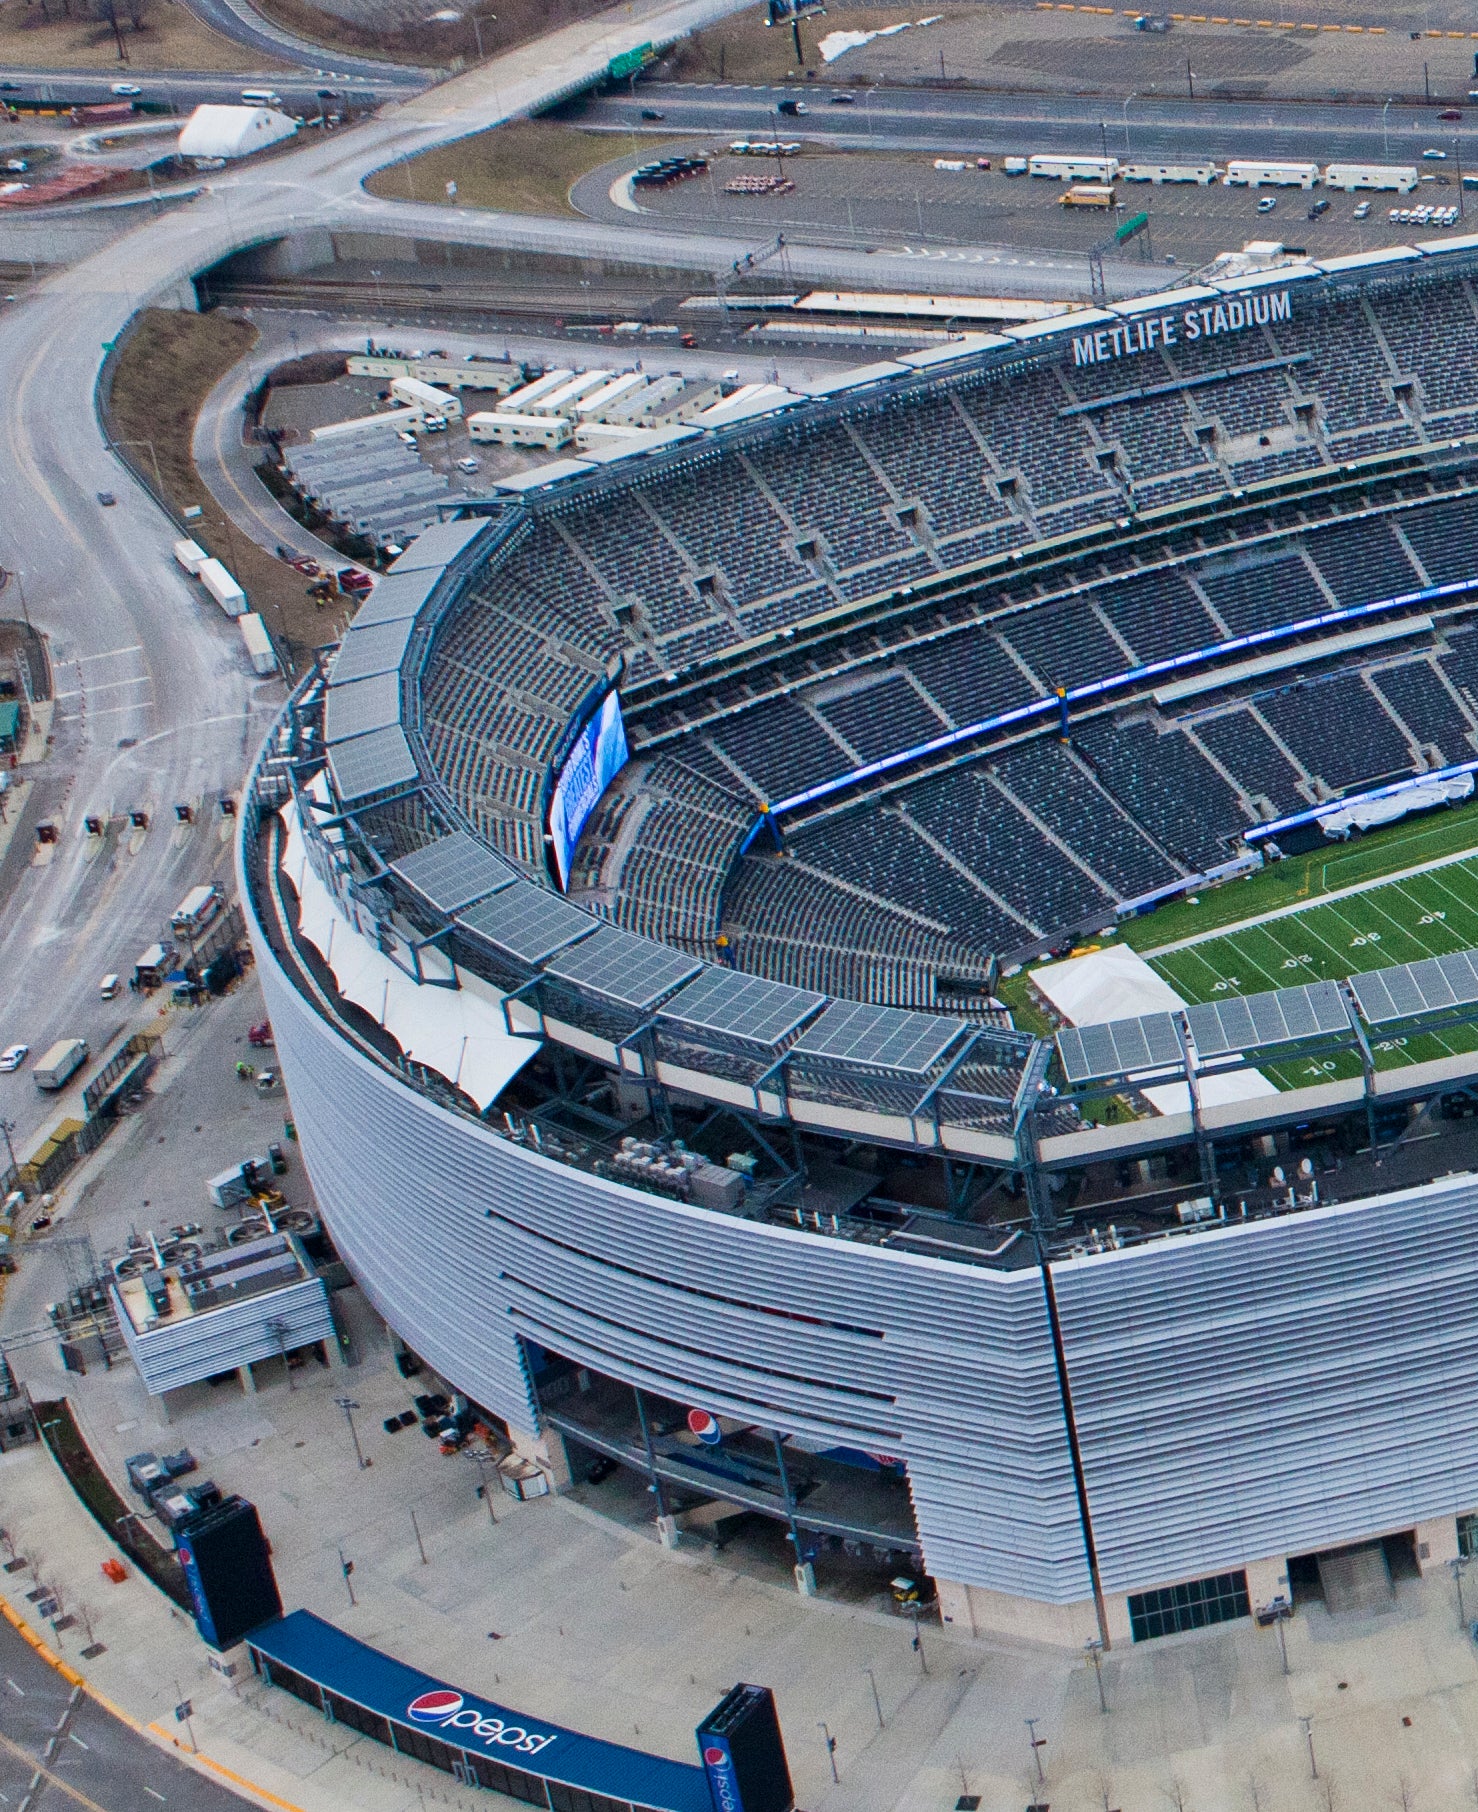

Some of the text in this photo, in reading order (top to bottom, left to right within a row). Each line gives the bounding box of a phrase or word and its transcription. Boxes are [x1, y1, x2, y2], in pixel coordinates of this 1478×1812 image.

[1072, 290, 1292, 366] METLIFE STADIUM
[440, 1709, 558, 1756] pepsi
